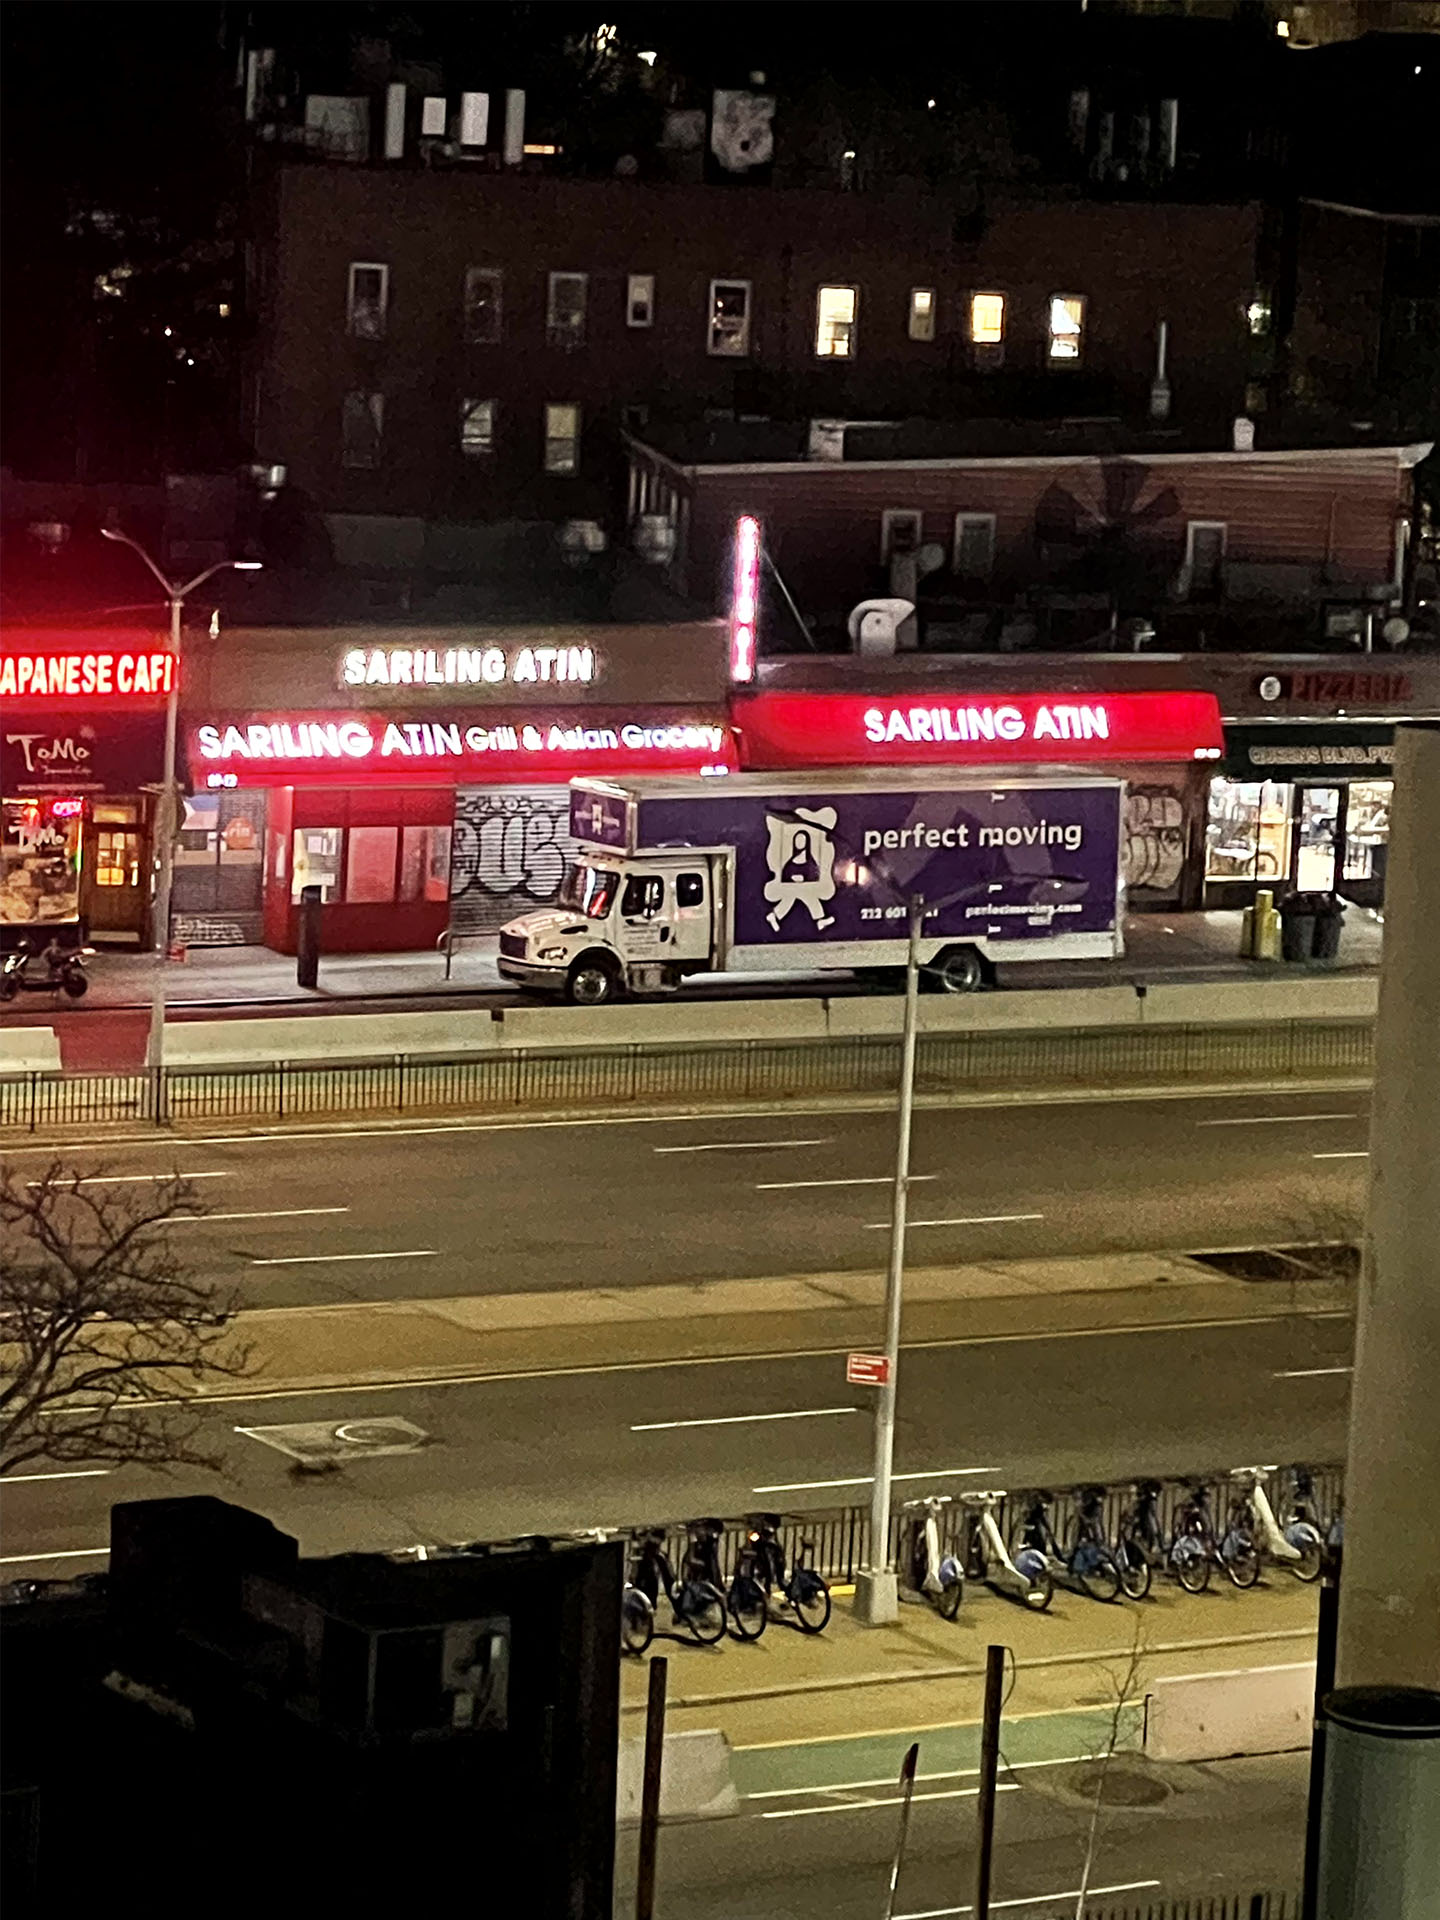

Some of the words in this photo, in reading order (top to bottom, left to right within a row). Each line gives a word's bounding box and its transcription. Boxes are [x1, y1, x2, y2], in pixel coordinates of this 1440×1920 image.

[0, 655, 114, 695] APANESE
[344, 649, 506, 684] SARILING
[513, 646, 595, 683] ATIN
[198, 722, 373, 758] SARILING
[381, 722, 463, 756] ATIN
[465, 726, 518, 750] Grill
[521, 725, 543, 750] &
[547, 725, 618, 750] Asian
[620, 724, 723, 752] Grocery
[864, 707, 1025, 743] SARILING
[1033, 705, 1110, 740] ATIN
[863, 822, 969, 856] perfect
[978, 820, 1083, 851] moving
[860, 907, 882, 920] 212
